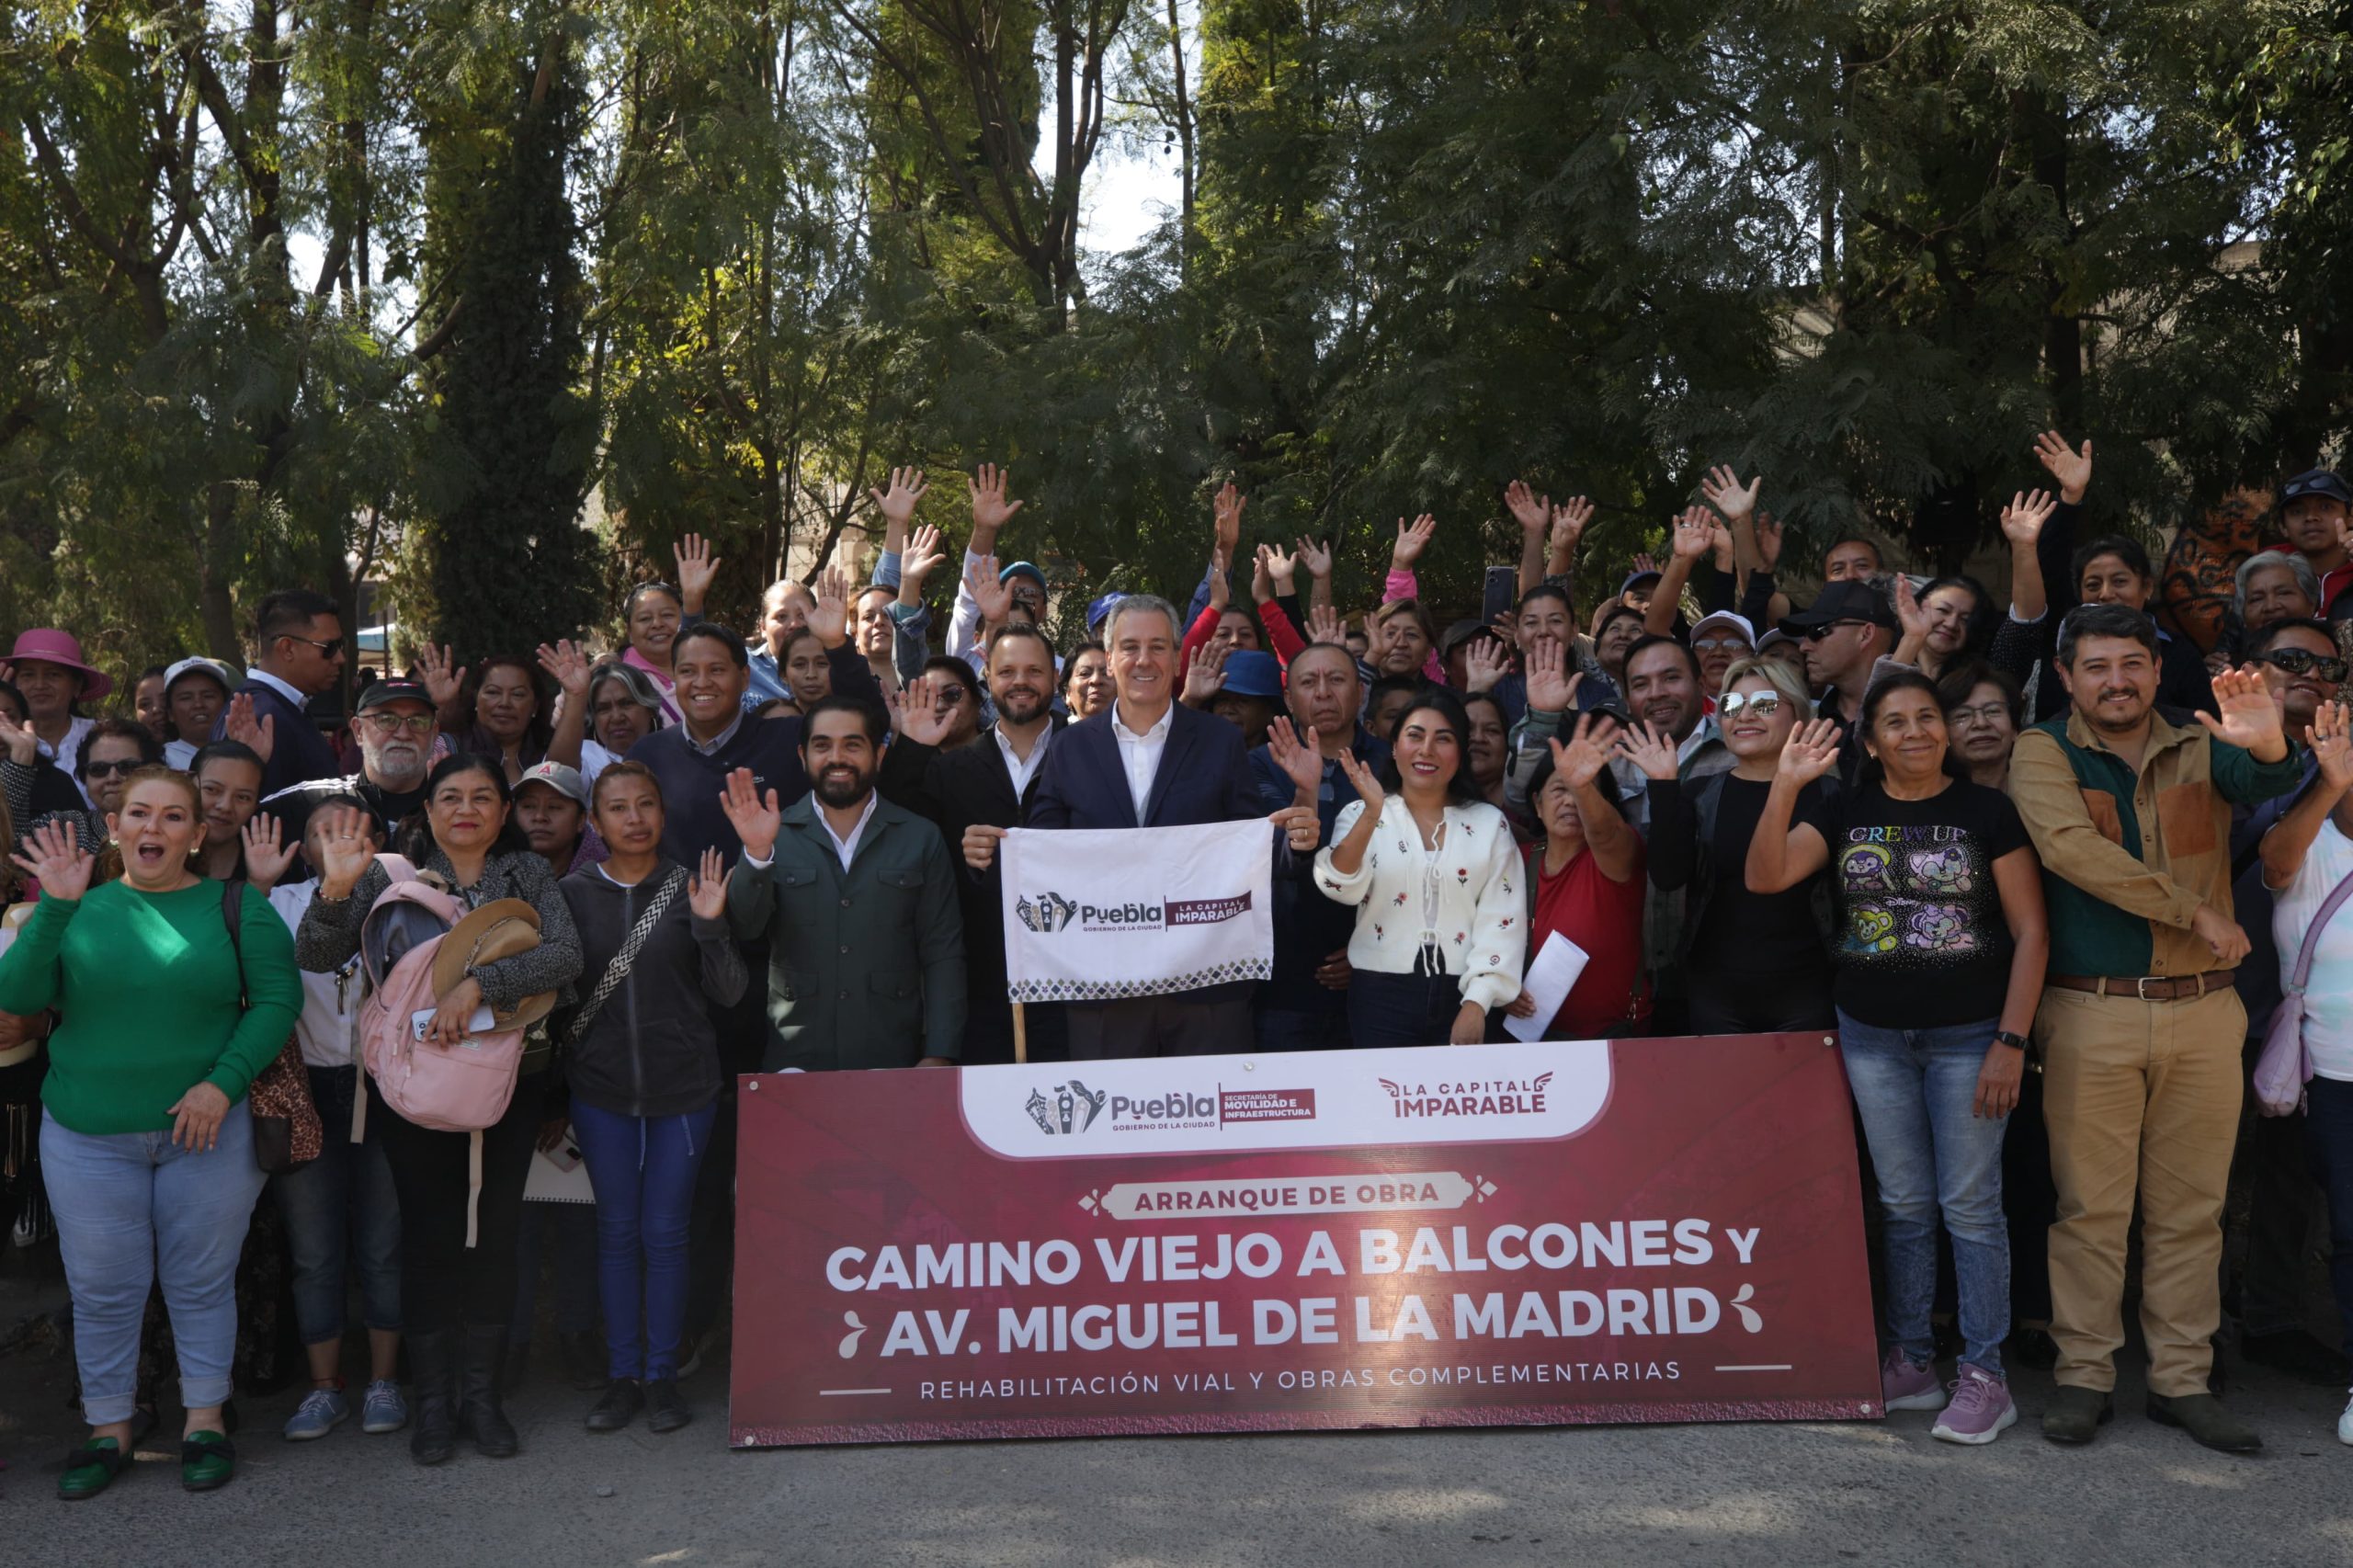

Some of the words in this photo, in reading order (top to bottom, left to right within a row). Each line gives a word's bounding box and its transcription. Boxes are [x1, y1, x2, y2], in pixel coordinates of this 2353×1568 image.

[1932, 825, 1966, 842] UP
[1082, 903, 1162, 924] Puebla
[1176, 902, 1245, 923] IMPARABLE
[1197, 900, 1241, 911] CAPITAL
[1224, 1092, 1267, 1101] SECRETARÍA
[1404, 1085, 1427, 1096] LA
[1438, 1080, 1531, 1095] CAPITAL
[1111, 1092, 1215, 1120] Puebla
[1224, 1099, 1288, 1110] MOVILIDAD
[1290, 1099, 1297, 1108] E
[1225, 1108, 1311, 1119] INFRAESTRUCTURA
[1395, 1094, 1546, 1118] IMPARABLE
[1134, 1187, 1298, 1211] ARRANQUE
[1309, 1186, 1347, 1205] DE
[1357, 1183, 1439, 1203] OBRA
[826, 1239, 1082, 1291] CAMINO
[1094, 1233, 1282, 1282] VIEJO
[1297, 1231, 1346, 1277] A
[1359, 1219, 1713, 1275] BALCONES
[1725, 1228, 1761, 1264] Y
[880, 1309, 982, 1357] AV.
[998, 1301, 1238, 1353] MIGUEL
[1254, 1297, 1339, 1346] DE
[1355, 1294, 1439, 1343] LA
[1452, 1287, 1721, 1340] MADRID
[921, 1371, 1159, 1400] REHABILITACIÓN
[1174, 1372, 1235, 1392] VIAL
[1250, 1371, 1265, 1390] Y
[1279, 1368, 1374, 1390] OBRAS
[1389, 1361, 1680, 1386] COMPLEMENTARIAS
